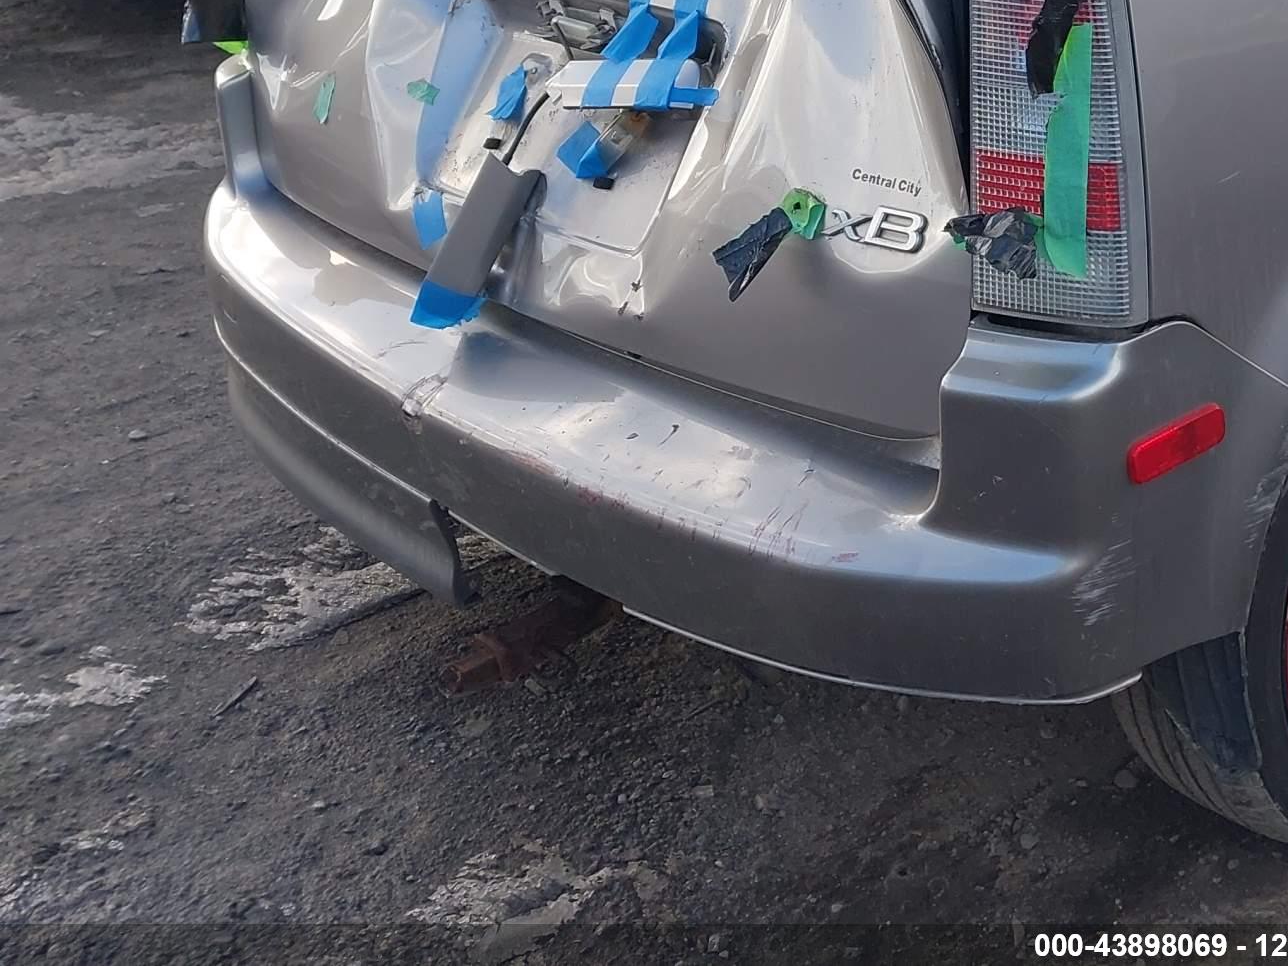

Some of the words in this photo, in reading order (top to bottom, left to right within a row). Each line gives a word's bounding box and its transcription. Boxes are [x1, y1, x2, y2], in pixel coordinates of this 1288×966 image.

[852, 168, 897, 189] Central
[898, 179, 922, 197] City
[821, 205, 928, 253] xB
